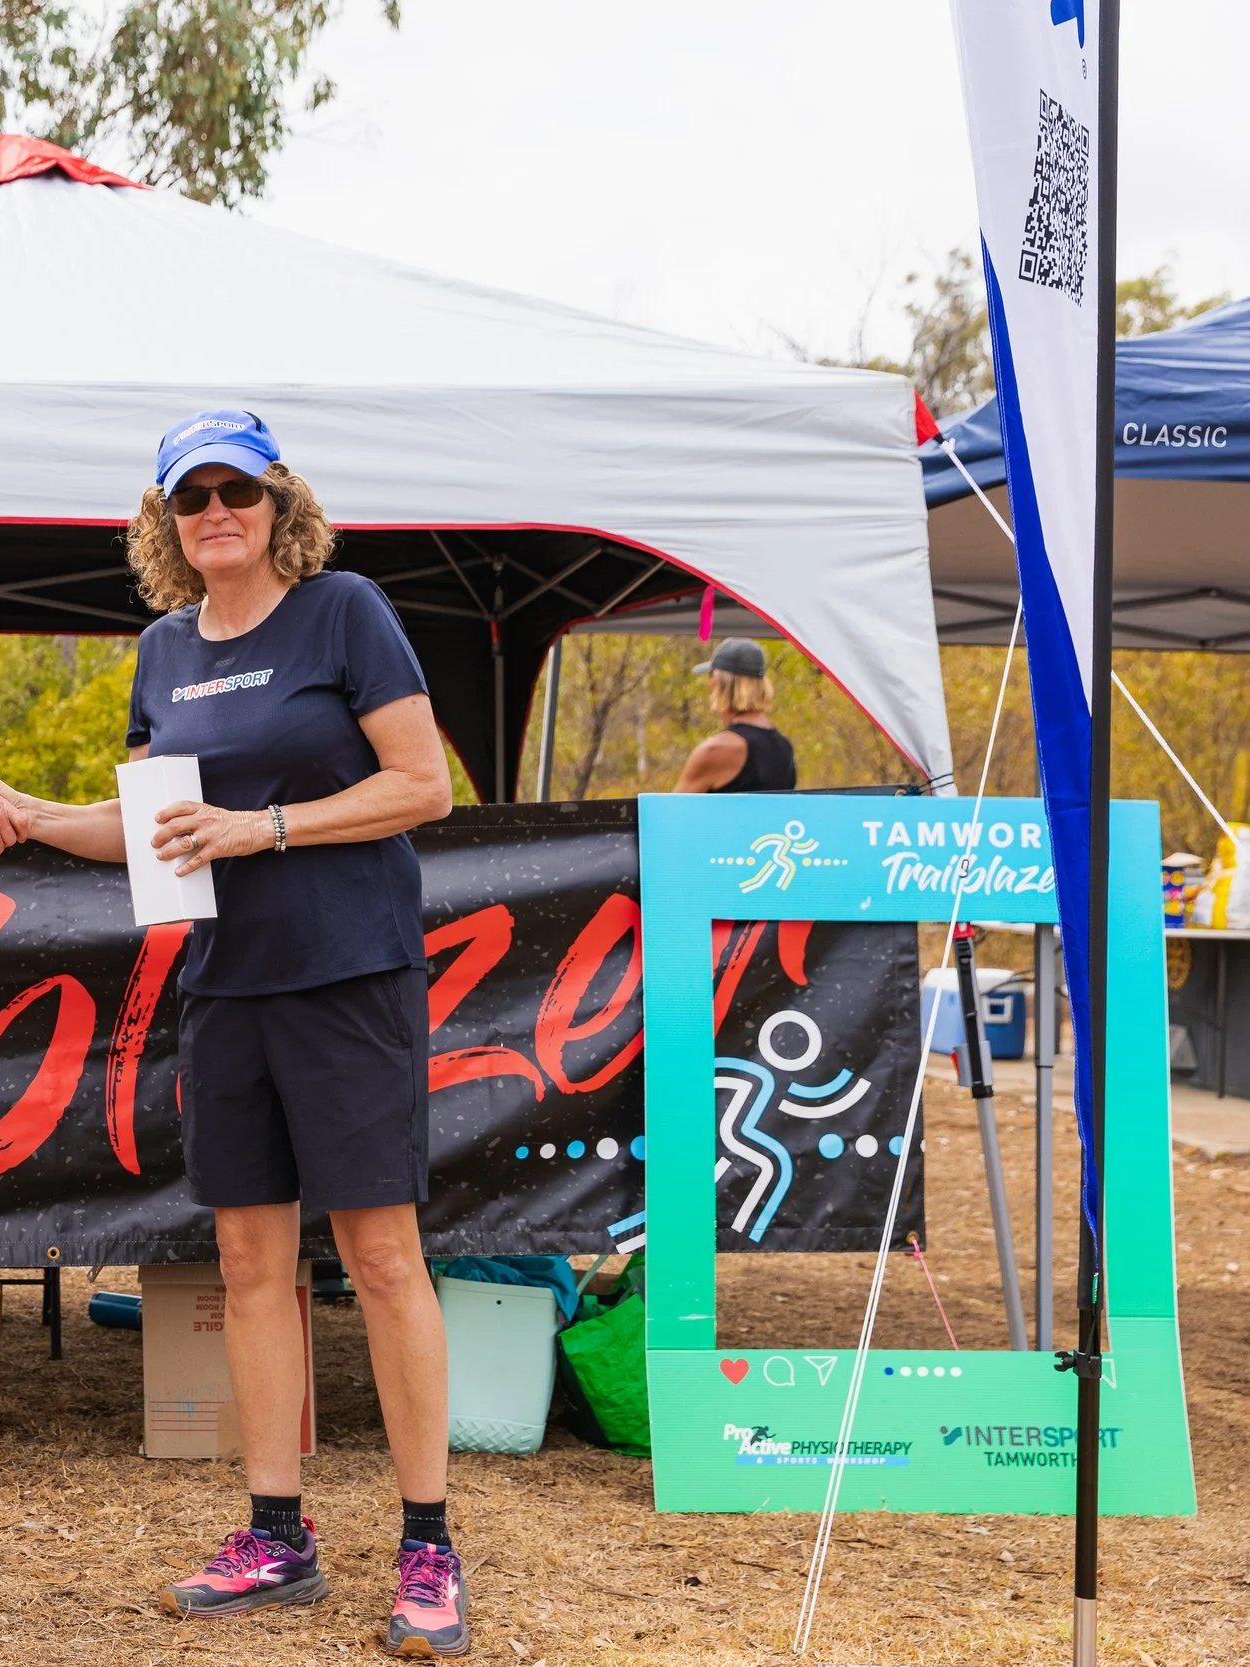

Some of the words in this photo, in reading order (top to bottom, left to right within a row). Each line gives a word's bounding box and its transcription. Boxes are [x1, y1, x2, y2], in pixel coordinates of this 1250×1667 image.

[1123, 422, 1227, 448] CLASSIC
[184, 668, 273, 701] INTERSPORT
[862, 821, 1050, 848] TAMWOR
[193, 1321, 225, 1332] GILE
[723, 1424, 754, 1440] Pro
[965, 1426, 1124, 1448] INTERSPRT
[776, 1457, 818, 1465] SPORTS
[826, 1457, 886, 1465] WRKSHOP
